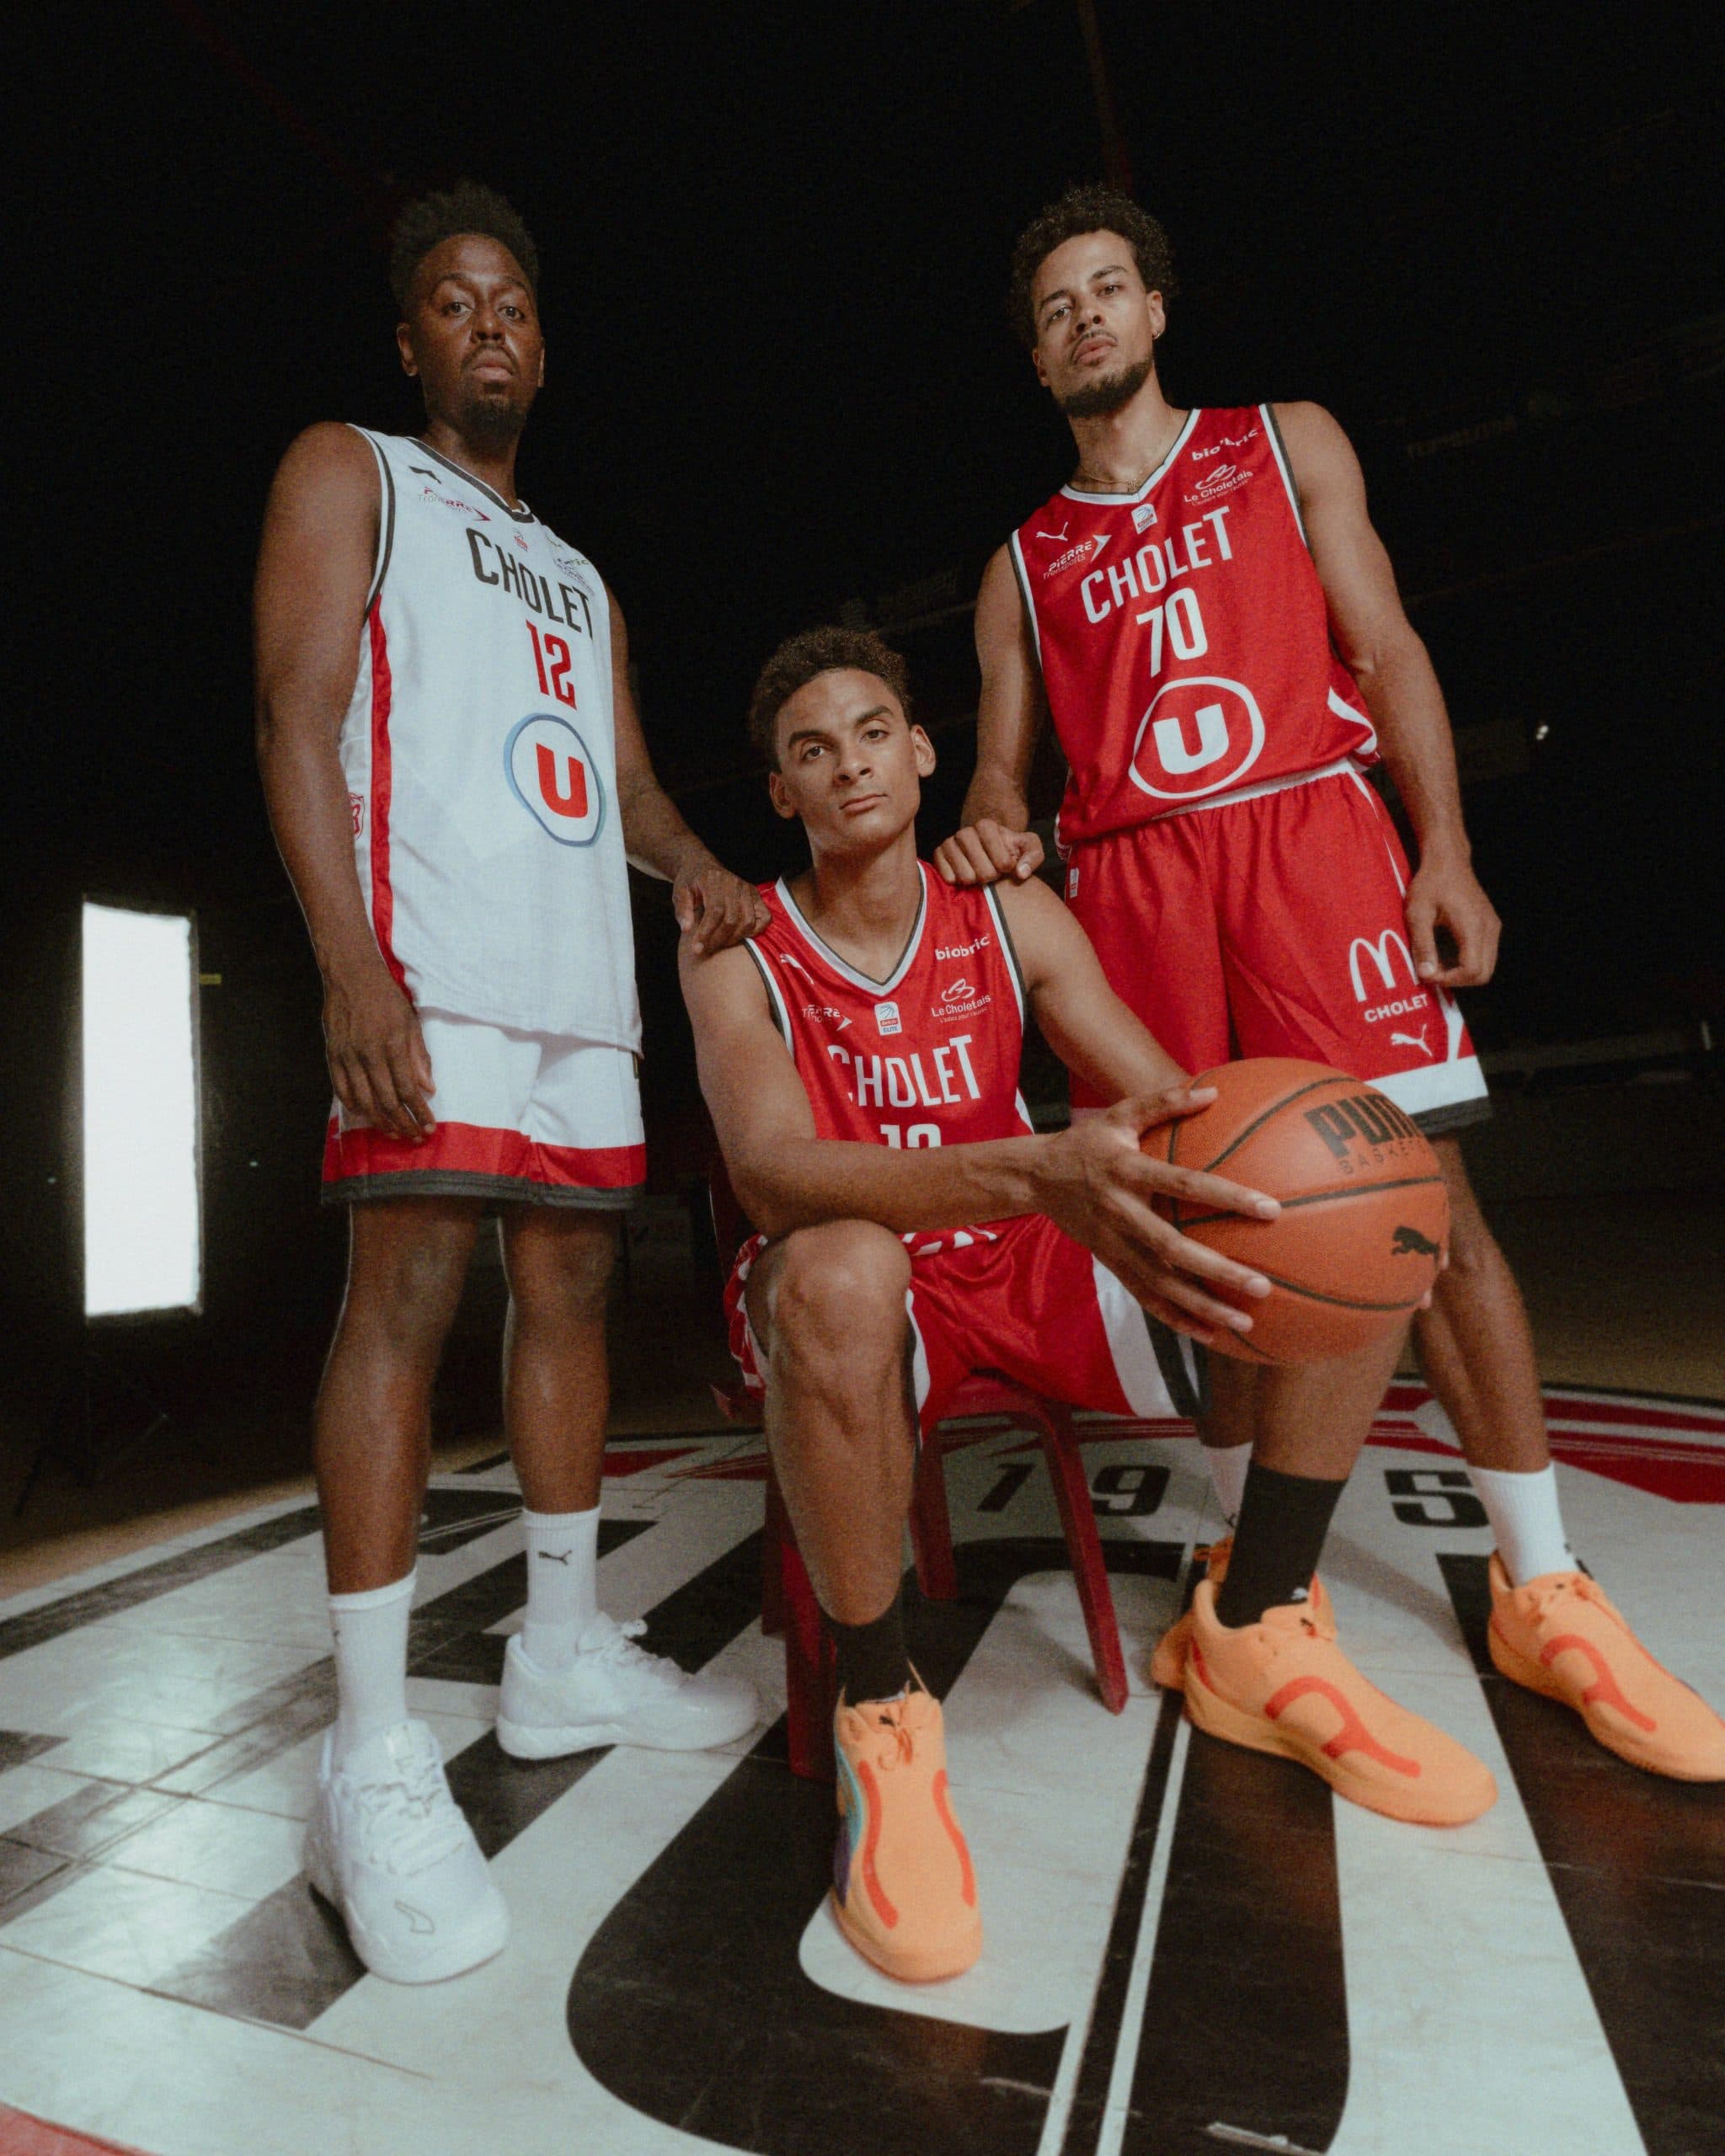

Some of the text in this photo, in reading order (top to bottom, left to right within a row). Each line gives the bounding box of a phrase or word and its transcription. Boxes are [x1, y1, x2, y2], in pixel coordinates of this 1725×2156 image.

[1183, 471, 1254, 503] Le Choletais
[466, 526, 593, 641] CHOLET
[1080, 506, 1232, 624] CHOLET
[526, 619, 577, 712] 12
[1135, 587, 1209, 679] 70
[1152, 703, 1230, 775] U
[535, 742, 589, 819] U
[931, 1006, 945, 1018] Le
[945, 994, 991, 1016] Choletais
[1363, 994, 1429, 1023] CHOLET
[1303, 1094, 1425, 1159] PUM
